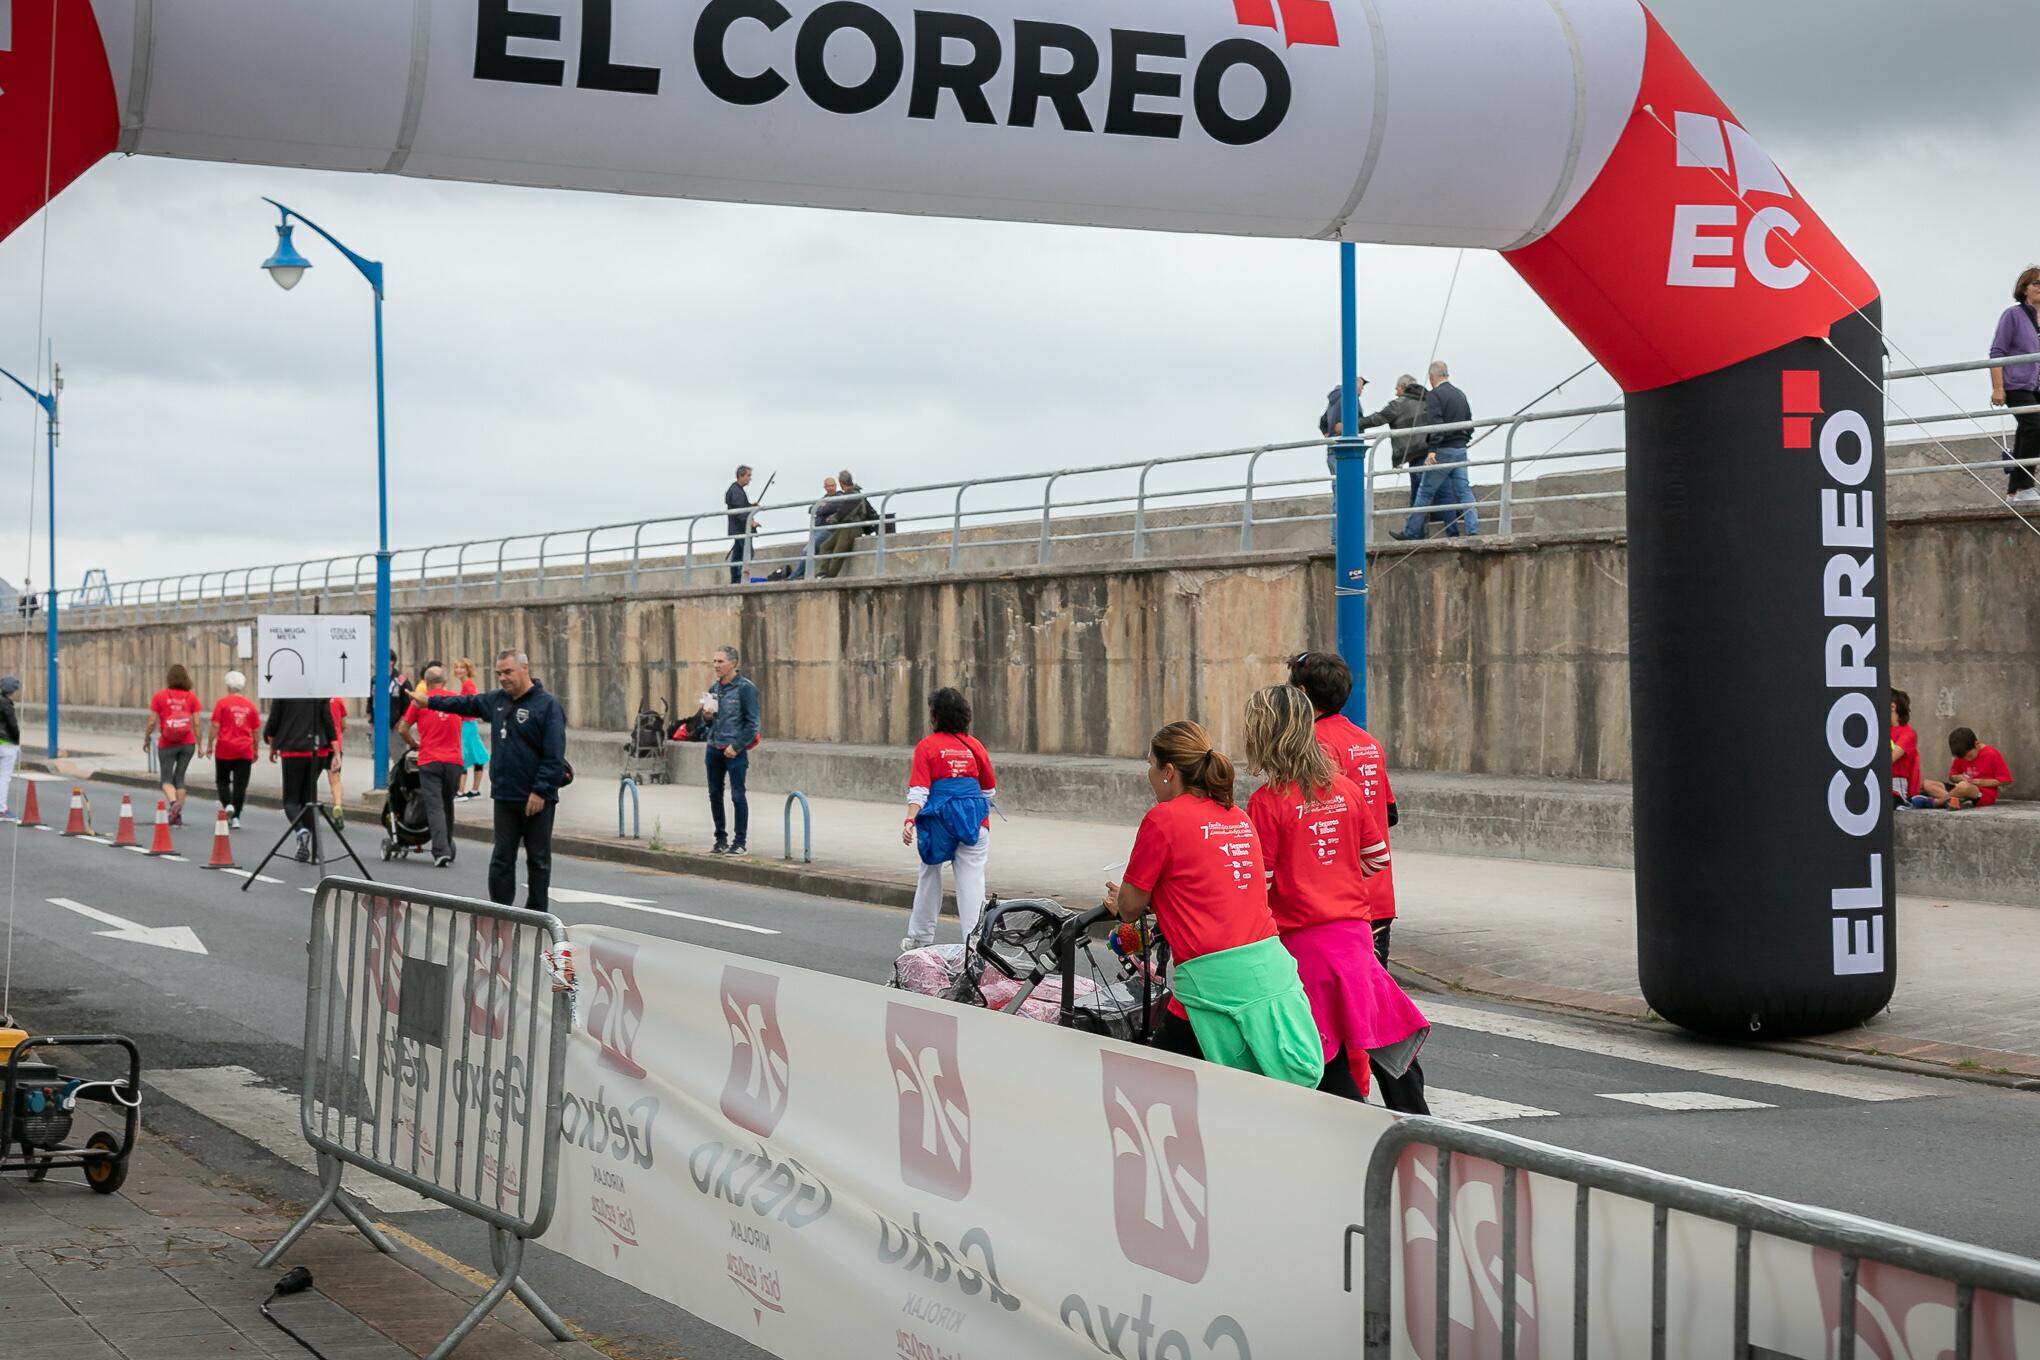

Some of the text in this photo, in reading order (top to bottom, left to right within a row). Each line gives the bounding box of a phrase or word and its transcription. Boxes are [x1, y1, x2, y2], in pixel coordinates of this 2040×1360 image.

[474, 0, 1293, 147] EL CORREO
[1666, 203, 1812, 291] EC
[1818, 408, 1885, 976] EL CORREO
